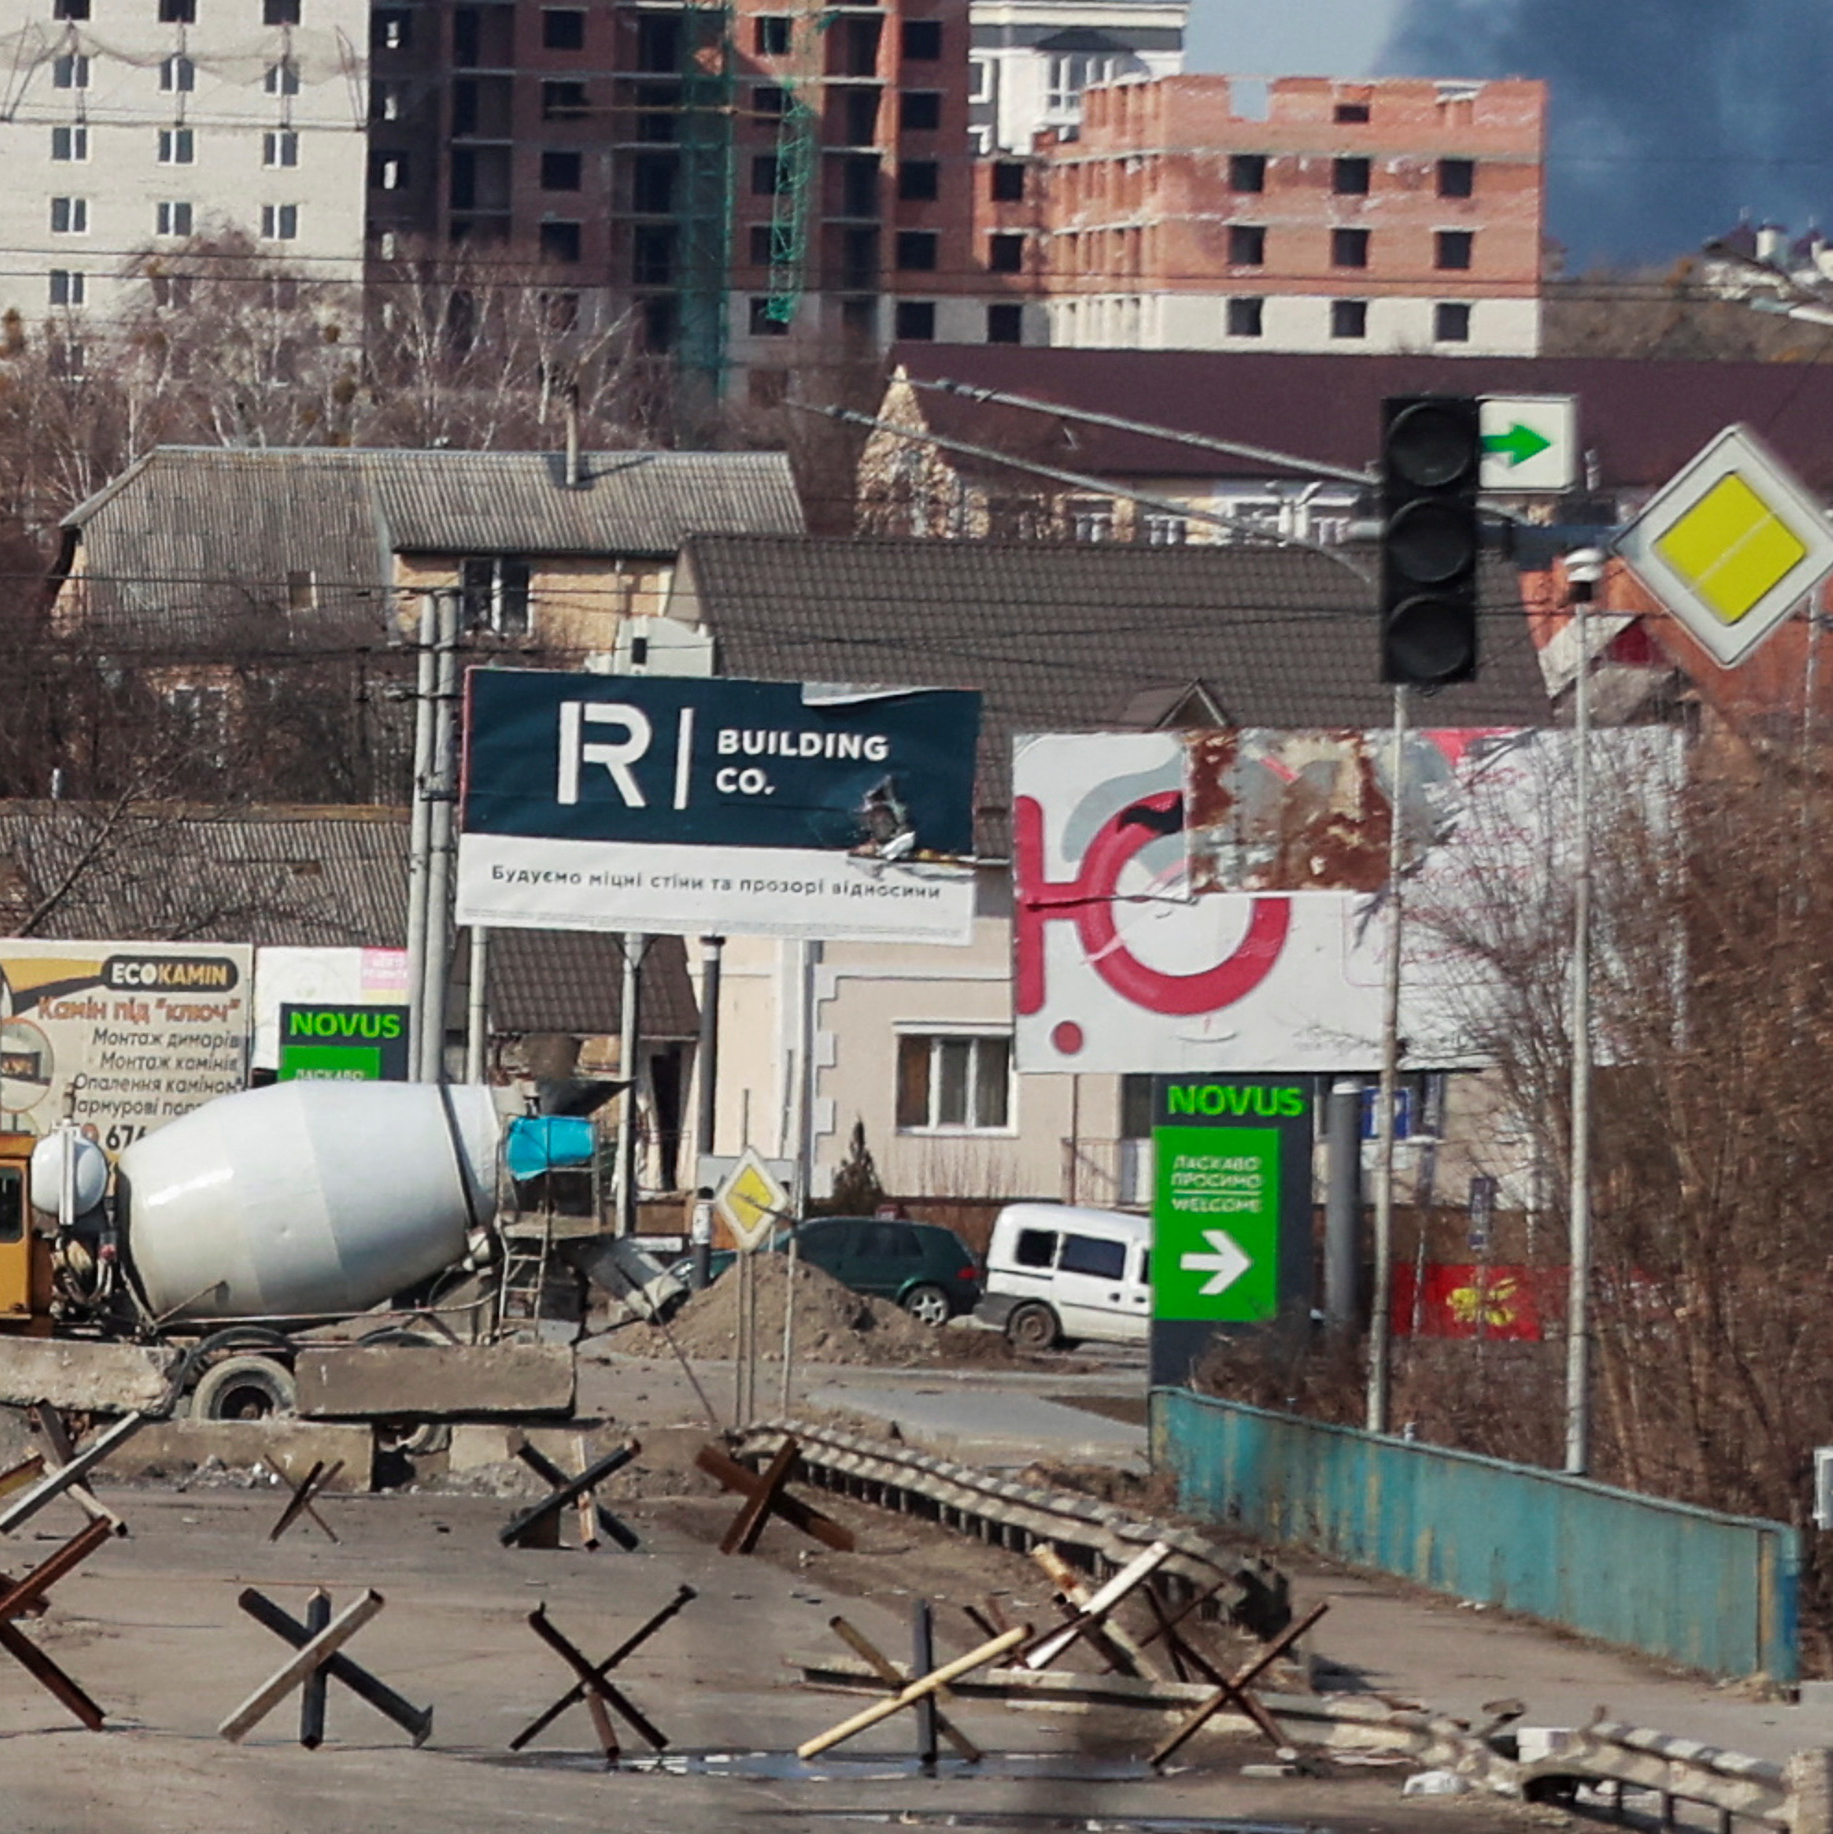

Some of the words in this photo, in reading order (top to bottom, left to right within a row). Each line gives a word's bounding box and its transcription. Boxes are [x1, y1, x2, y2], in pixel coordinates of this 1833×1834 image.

[556, 700, 653, 809] R
[715, 727, 890, 763] BUILDING
[715, 766, 777, 797] CO.
[491, 864, 582, 885] Будуємо
[589, 871, 643, 889] міцні
[650, 873, 705, 890] стіни
[709, 877, 733, 892] та
[739, 878, 824, 896] прозорі
[831, 880, 942, 900] відносини
[111, 961, 229, 986] ECOKAMIN
[38, 996, 107, 1021] Камін
[113, 996, 151, 1024] під
[92, 1028, 163, 1047] Монтаж
[289, 1011, 401, 1040] NOVUS
[99, 1053, 171, 1071] Монтаж
[73, 1072, 162, 1092] Опалення
[73, 1096, 160, 1119] армурові
[1167, 1084, 1306, 1117] NOVUS
[1172, 1155, 1263, 1171] ЛАСКАВО
[1170, 1172, 1264, 1188] ПРОСИМО
[1171, 1197, 1263, 1214] WELCOME
